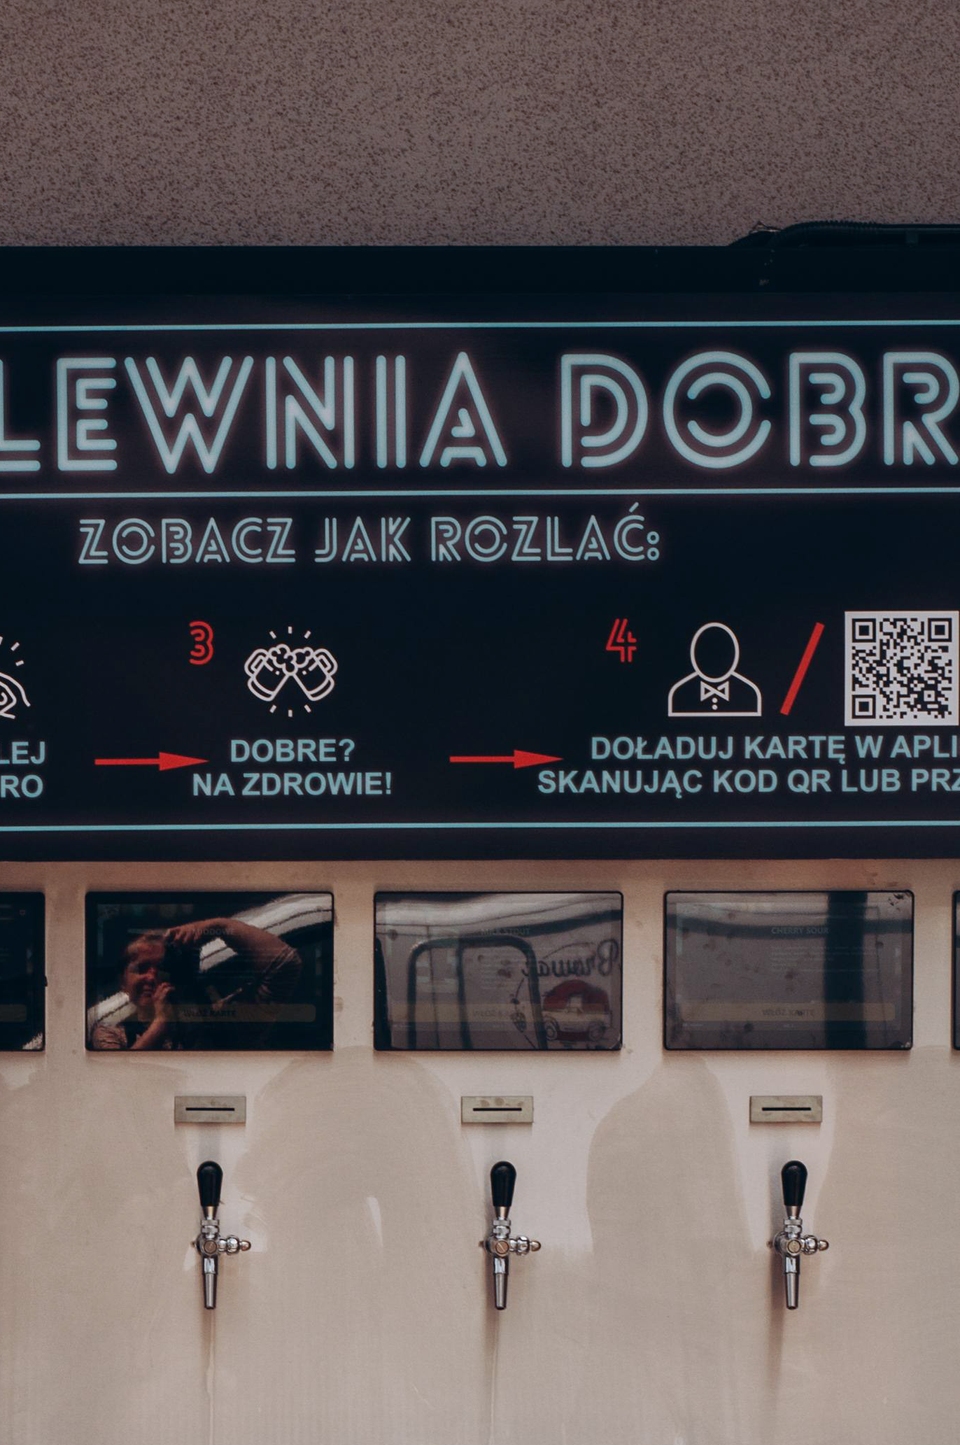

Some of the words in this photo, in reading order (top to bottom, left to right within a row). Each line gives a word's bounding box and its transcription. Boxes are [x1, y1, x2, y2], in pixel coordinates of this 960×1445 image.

[561, 351, 959, 469] DOBR
[79, 517, 295, 564] ZOBACZ
[315, 516, 411, 562] JAK
[431, 502, 659, 562] ROZLAĆ:
[189, 621, 213, 664] 3
[606, 619, 637, 662] 4
[231, 739, 355, 762] DOBRE?
[592, 736, 733, 759] DOŁADUJ
[745, 736, 845, 764] KARTĘ
[855, 736, 884, 758] W
[193, 773, 235, 796] NA
[242, 772, 391, 795] ZDROWIE!
[538, 770, 702, 798] SKANUJĄC
[714, 770, 777, 792] KOD
[788, 769, 831, 793] QR
[842, 769, 900, 792] LUB
